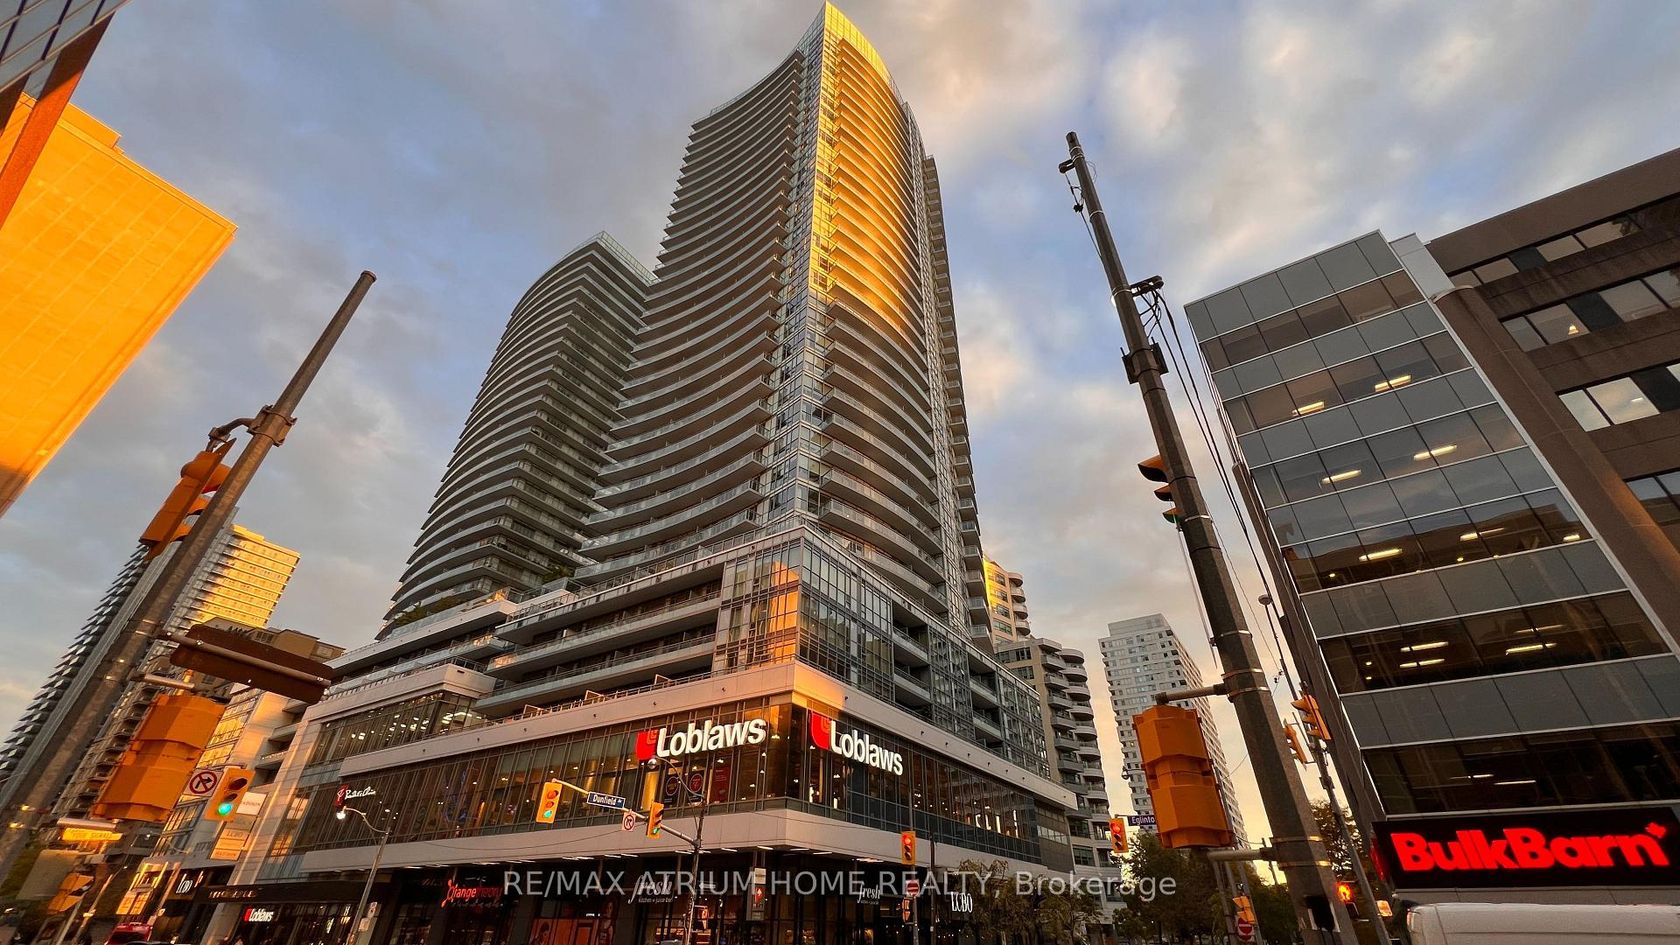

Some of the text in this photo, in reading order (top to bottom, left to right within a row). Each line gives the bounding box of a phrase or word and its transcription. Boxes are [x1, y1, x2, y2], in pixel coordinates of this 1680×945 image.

[656, 718, 767, 758] Loblaws
[830, 720, 904, 776] Loblaws
[1131, 816, 1156, 825] Eglinto
[1390, 827, 1670, 871] BulkBarn
